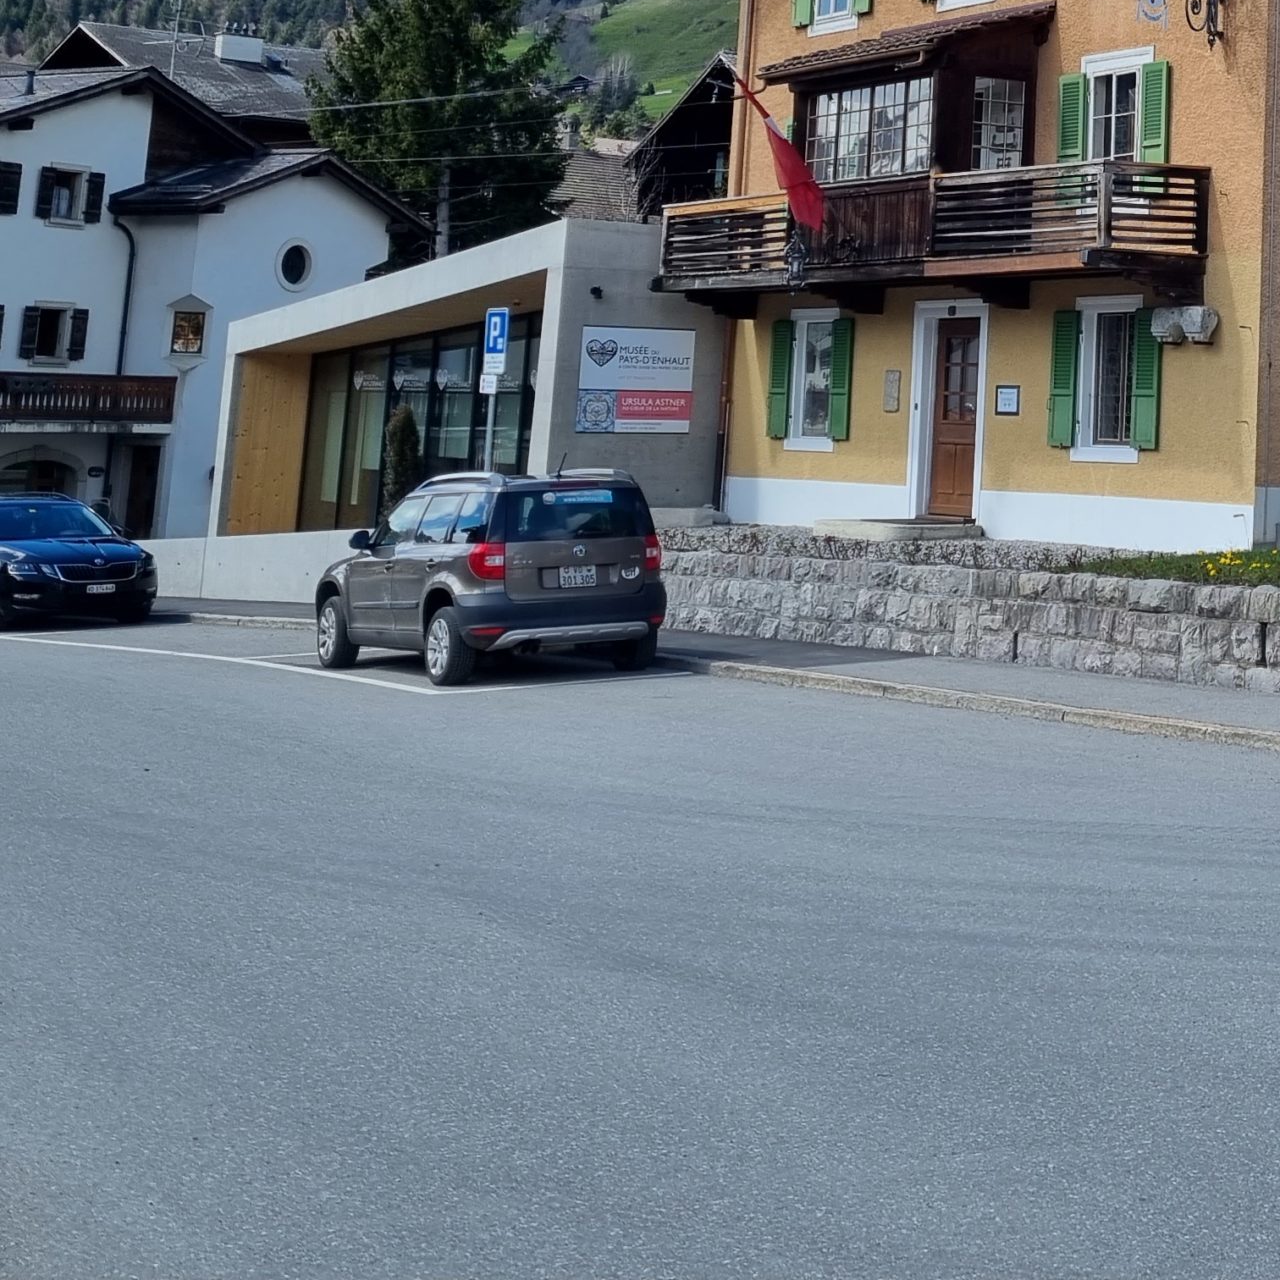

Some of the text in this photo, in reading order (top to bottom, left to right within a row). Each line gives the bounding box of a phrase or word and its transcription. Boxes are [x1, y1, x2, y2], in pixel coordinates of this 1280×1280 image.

[489, 315, 502, 349] P
[619, 345, 649, 355] MUSÉE
[618, 355, 691, 365] PAYS-D'ENHAUT
[621, 397, 686, 407] URSULA ASTNER
